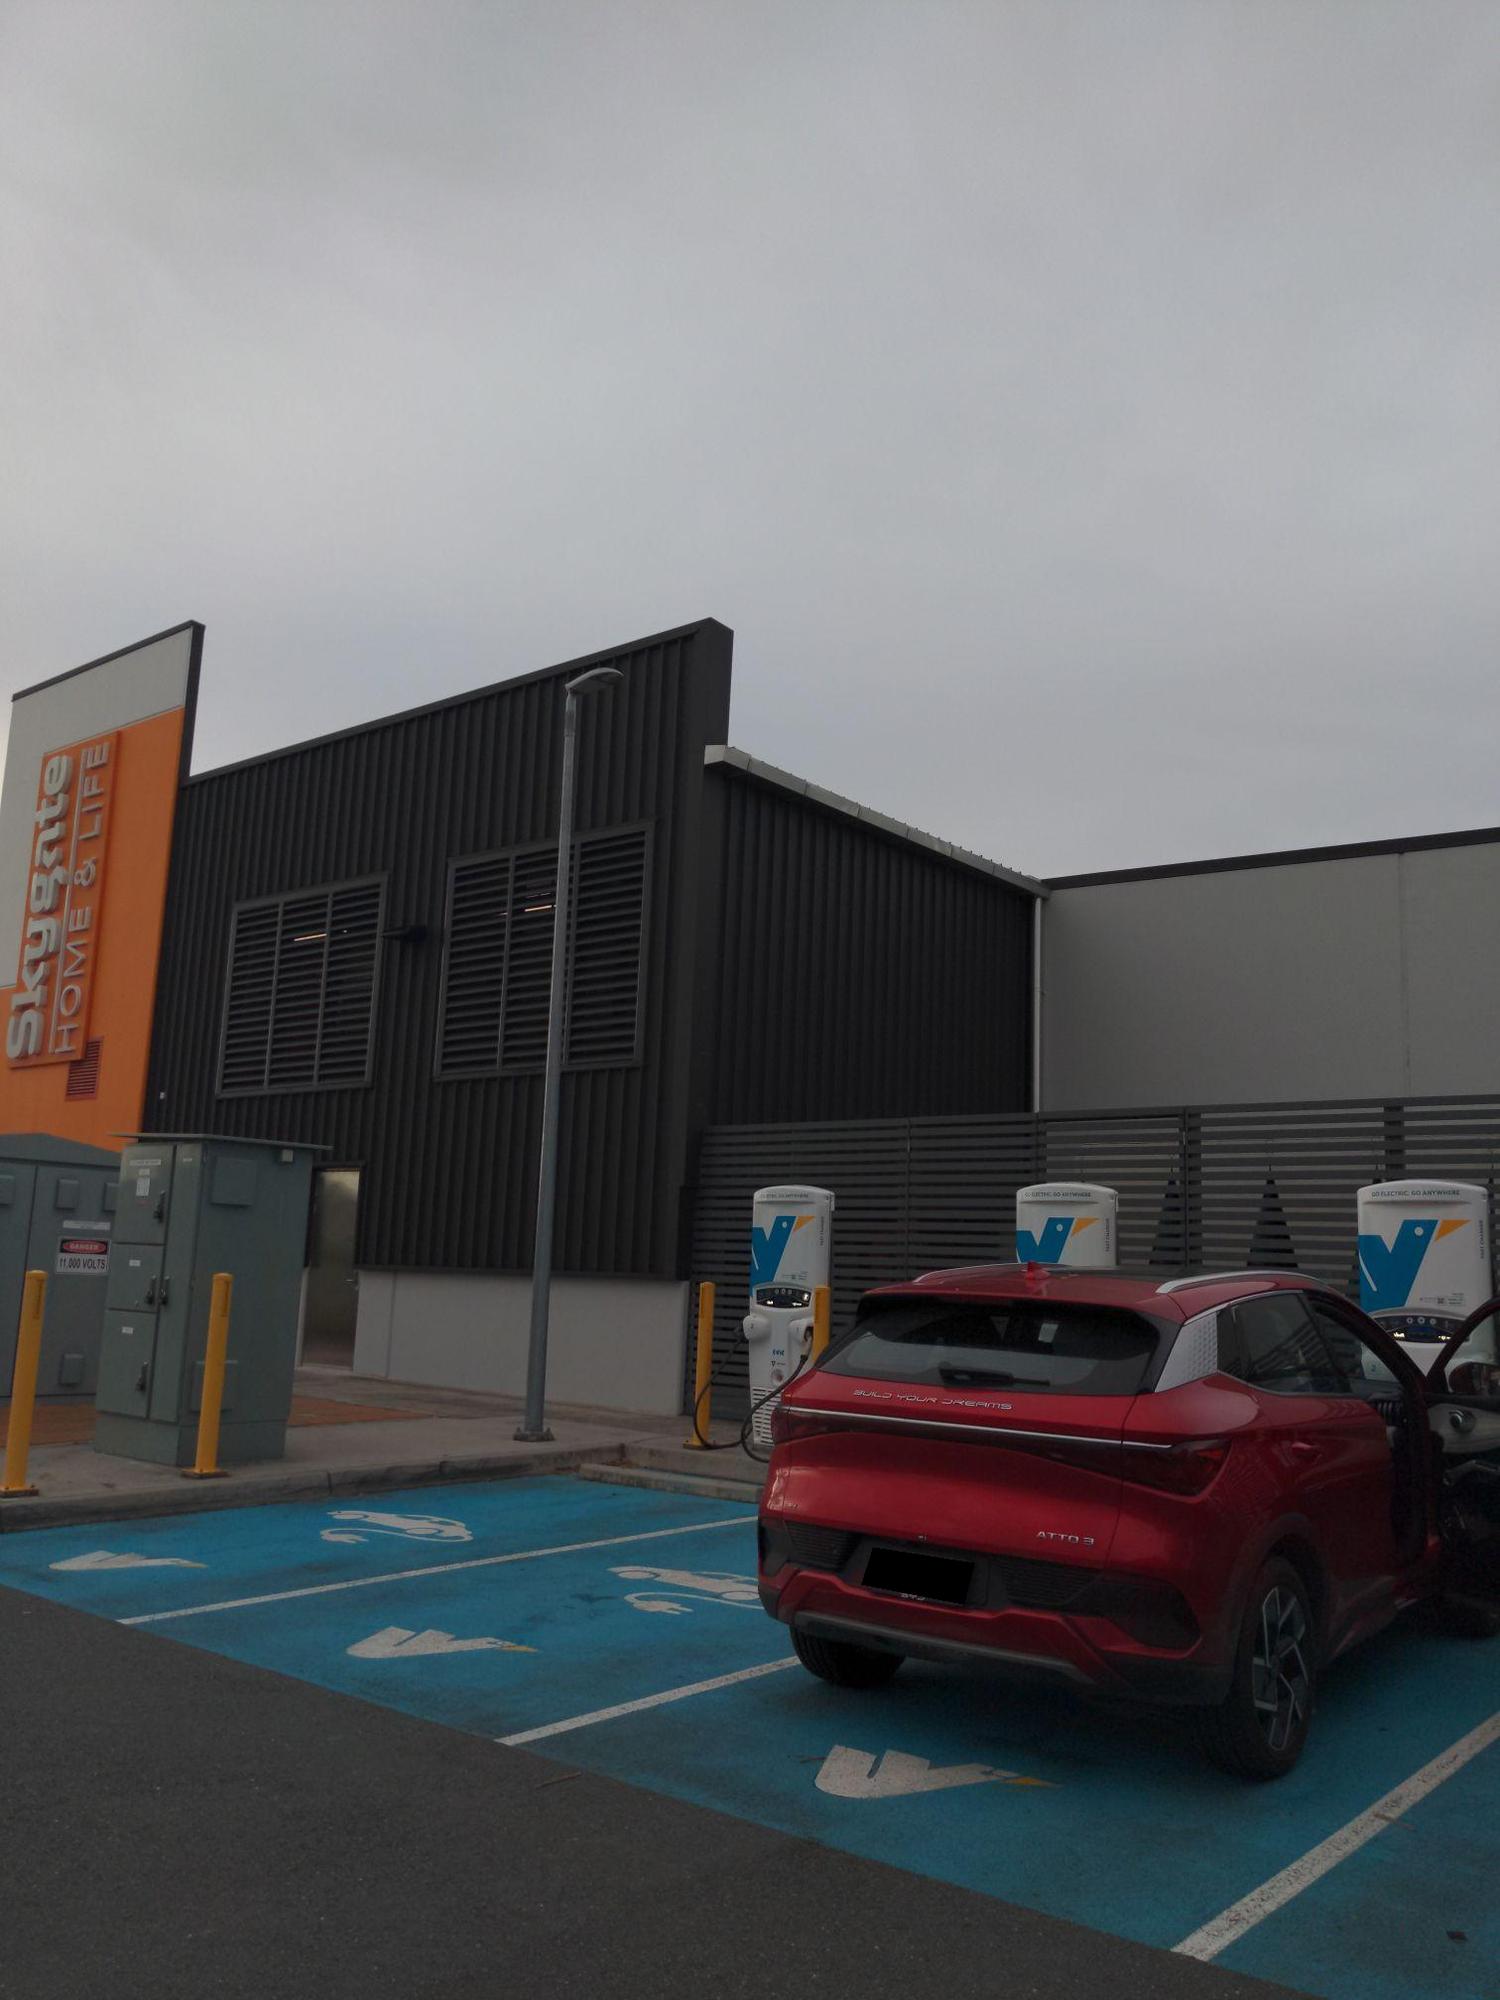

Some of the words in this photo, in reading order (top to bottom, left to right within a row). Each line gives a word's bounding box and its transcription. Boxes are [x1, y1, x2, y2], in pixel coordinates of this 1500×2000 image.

[78, 742, 109, 841] LIFE
[72, 857, 98, 887] &
[6, 755, 73, 1060] Skygate
[54, 906, 92, 1054] HOME
[82, 1258, 106, 1270] VOLTS
[852, 1388, 893, 1399] BUILD
[896, 1392, 938, 1404] YOUR
[941, 1398, 1013, 1410] DREAMS
[1036, 1530, 1080, 1544] ATTO
[1082, 1535, 1095, 1546] 3
